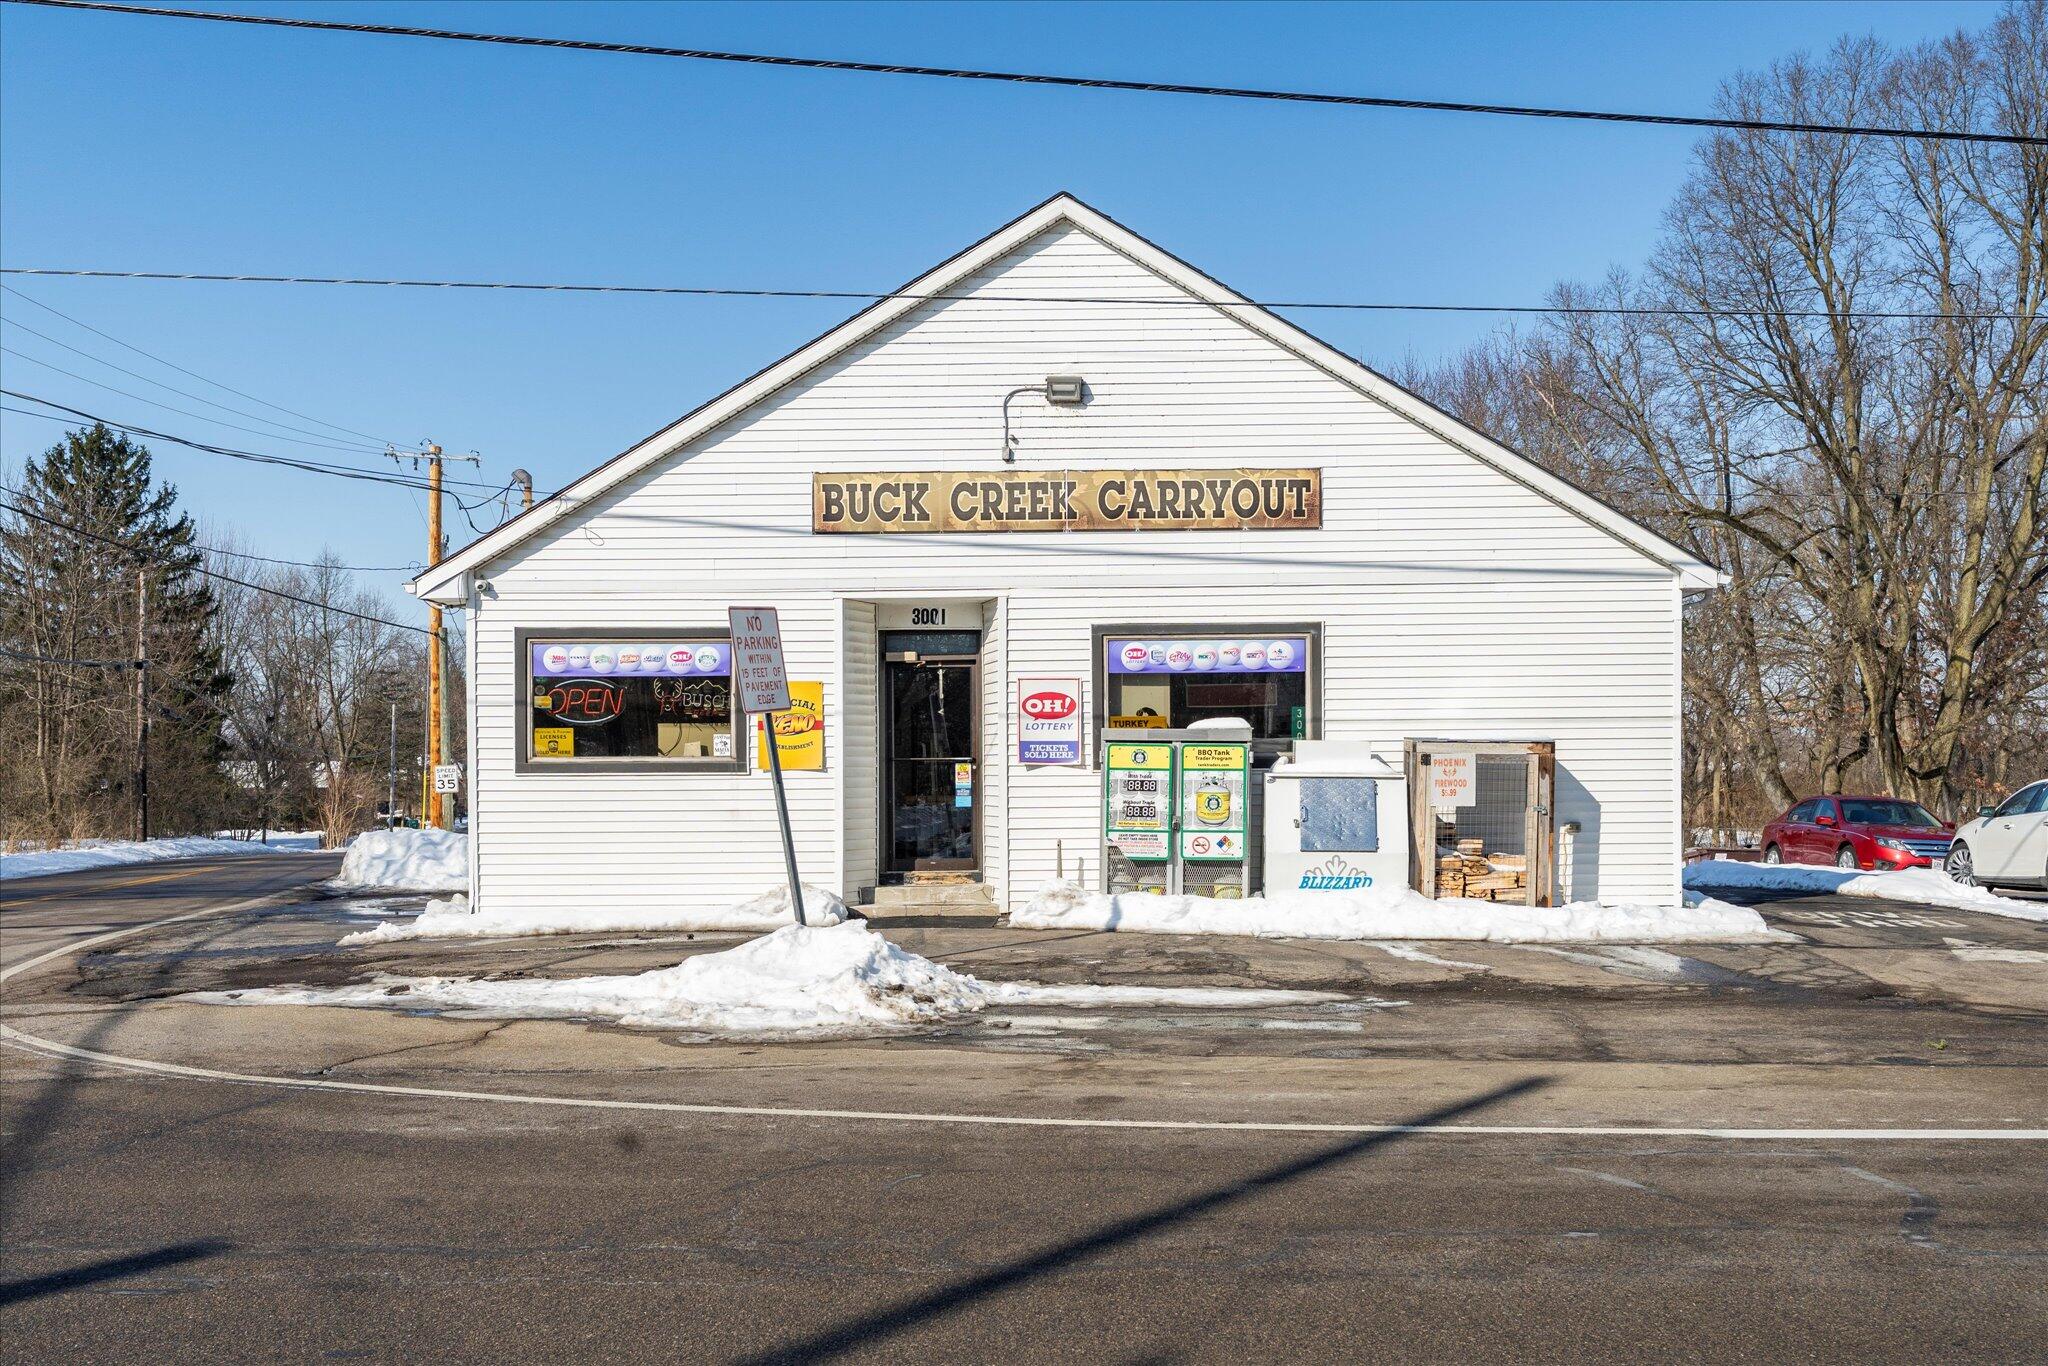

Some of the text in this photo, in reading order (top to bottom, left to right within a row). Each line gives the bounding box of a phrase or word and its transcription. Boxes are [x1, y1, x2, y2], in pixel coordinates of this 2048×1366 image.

[820, 477, 1314, 522] BUCK CREEK CARRYOUT
[912, 607, 946, 625] 3001
[745, 615, 762, 632] NO
[736, 636, 778, 650] PARKING
[747, 653, 772, 664] WITHIN
[752, 667, 768, 678] FEET
[773, 666, 782, 676] OF
[745, 680, 783, 692] PAVEMENT
[546, 687, 624, 715] OPEN
[682, 692, 731, 709] BUSCH
[757, 694, 776, 705] EDGE
[790, 698, 816, 711] CIAL
[1025, 697, 1072, 713] OH!
[772, 713, 816, 736] KENO
[1113, 720, 1149, 728] TURKEY
[776, 740, 814, 751] ABLISHMENT
[1433, 758, 1467, 767] PHOENIX
[437, 779, 456, 790] 35
[1127, 780, 1157, 791] 88.88
[1434, 779, 1467, 788] FIREWOOD
[1126, 805, 1156, 817] 88.88
[1298, 876, 1373, 889] BLIZZARD
